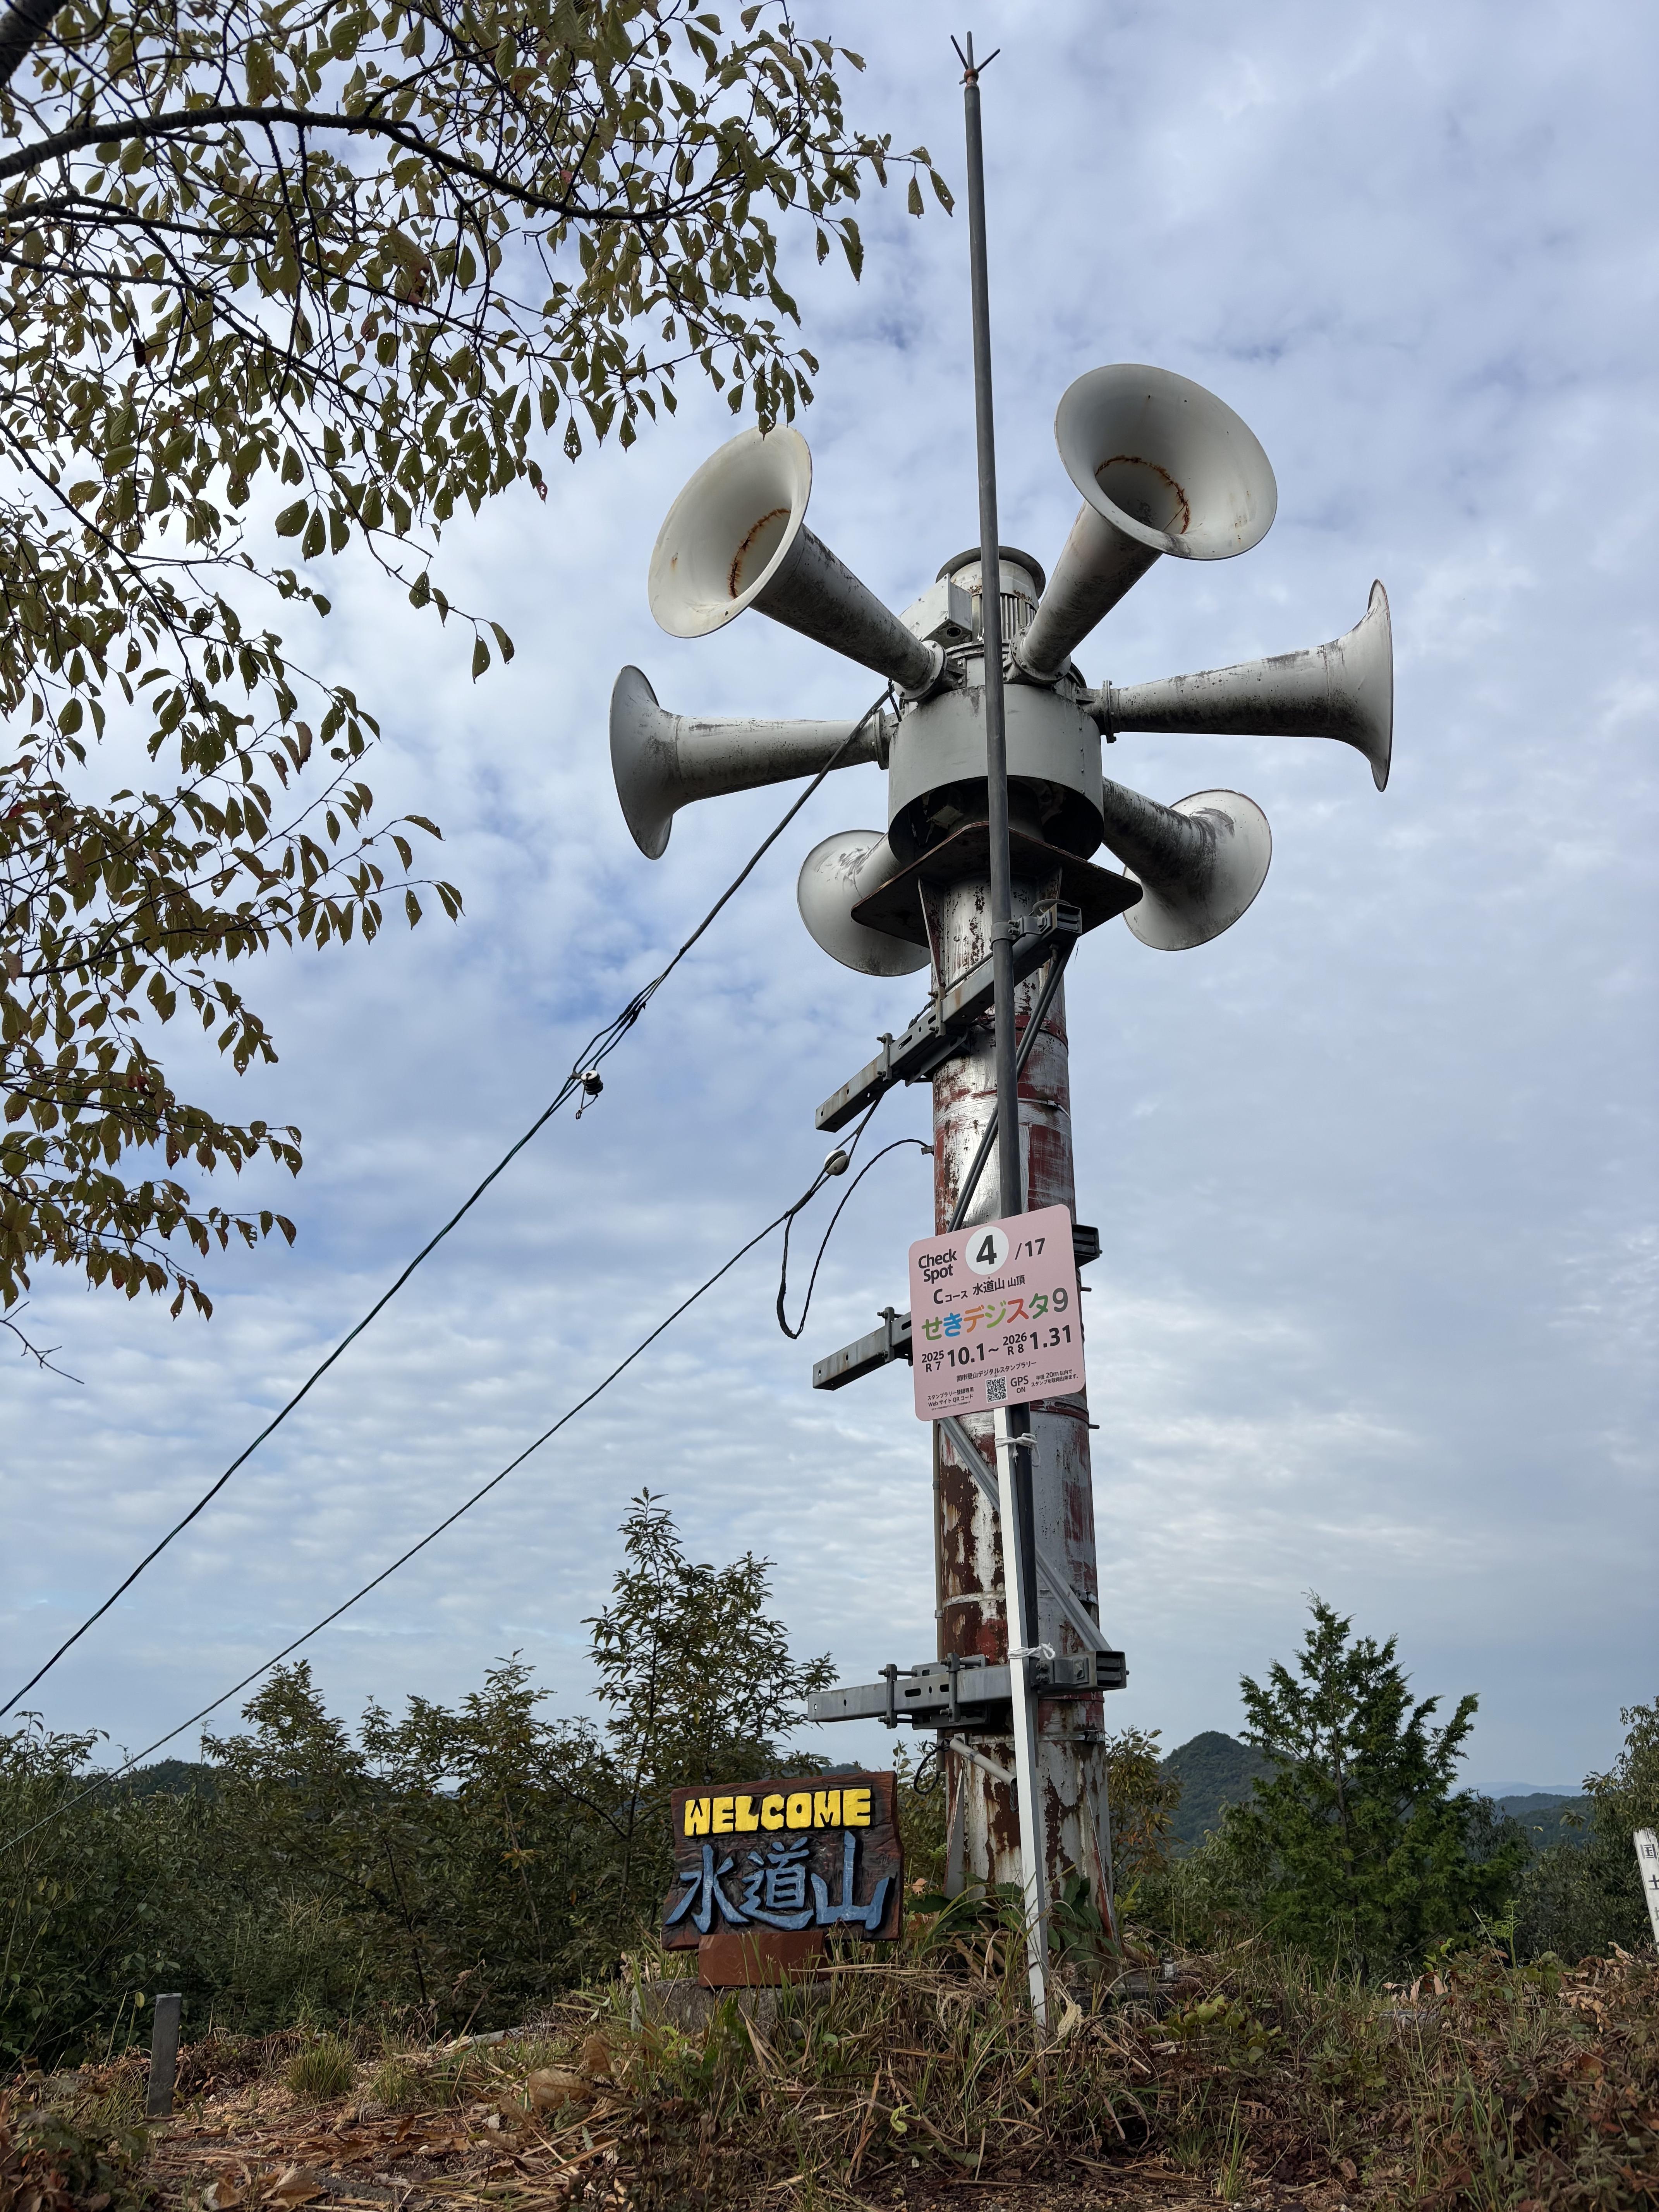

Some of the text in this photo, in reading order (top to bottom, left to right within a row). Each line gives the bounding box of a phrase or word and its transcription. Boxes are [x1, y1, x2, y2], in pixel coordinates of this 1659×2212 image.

[918, 1249, 957, 1269] Check
[975, 1234, 997, 1265] 4
[923, 1266, 953, 1284] Spot
[972, 1278, 1005, 1295] 水道山
[1008, 1274, 1025, 1288] 山頂
[921, 1287, 1068, 1341] せきデジスタ9
[921, 1350, 944, 1364] 2025
[1003, 1332, 1028, 1346] 2026
[1030, 1324, 1072, 1350] 1.31
[1010, 1375, 1029, 1387] GPS
[684, 1788, 871, 1837] WELCOME
[665, 1830, 891, 1934] 水道山
